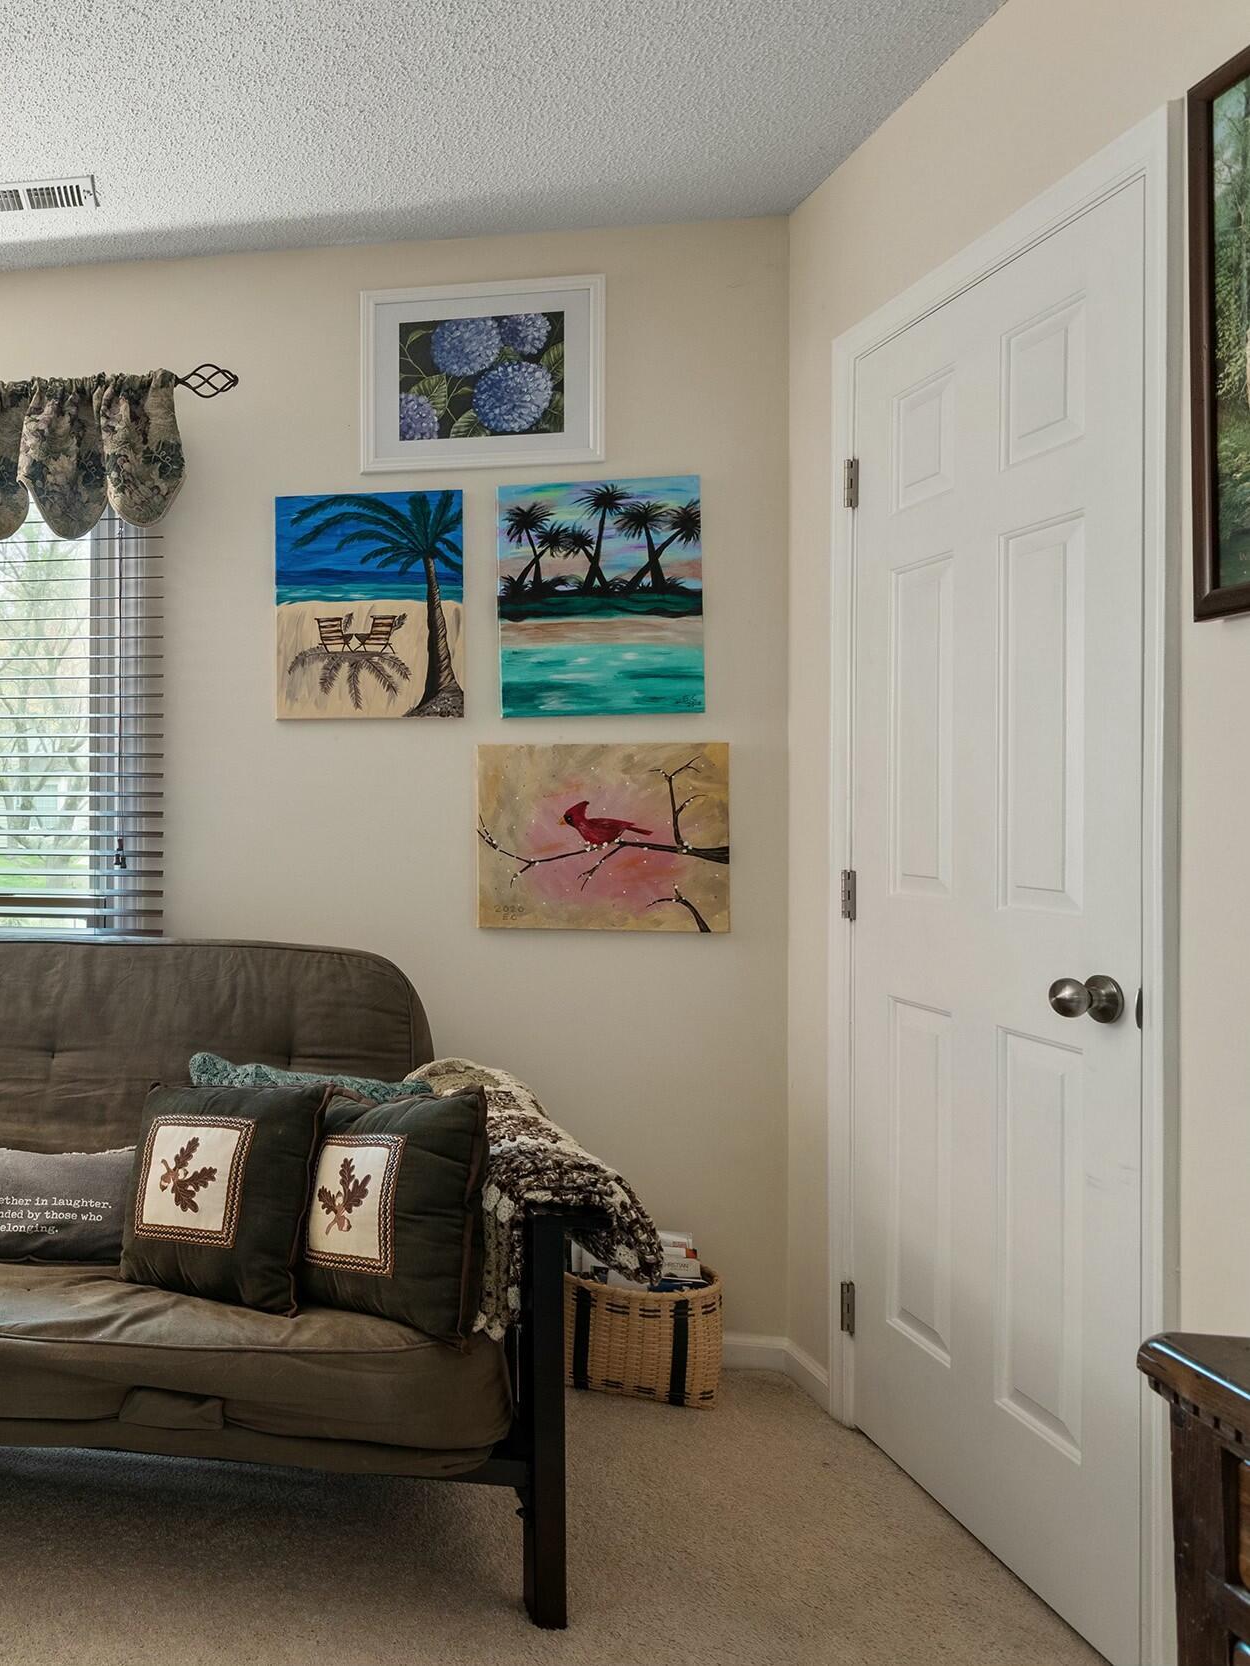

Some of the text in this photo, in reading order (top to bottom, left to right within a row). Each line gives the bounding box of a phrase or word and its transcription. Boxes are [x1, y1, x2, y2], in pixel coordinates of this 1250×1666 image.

[35, 1196, 48, 1206] in
[52, 1197, 112, 1209] laughter.
[27, 1210, 42, 1220] by
[45, 1210, 78, 1220] those
[81, 1212, 103, 1221] who
